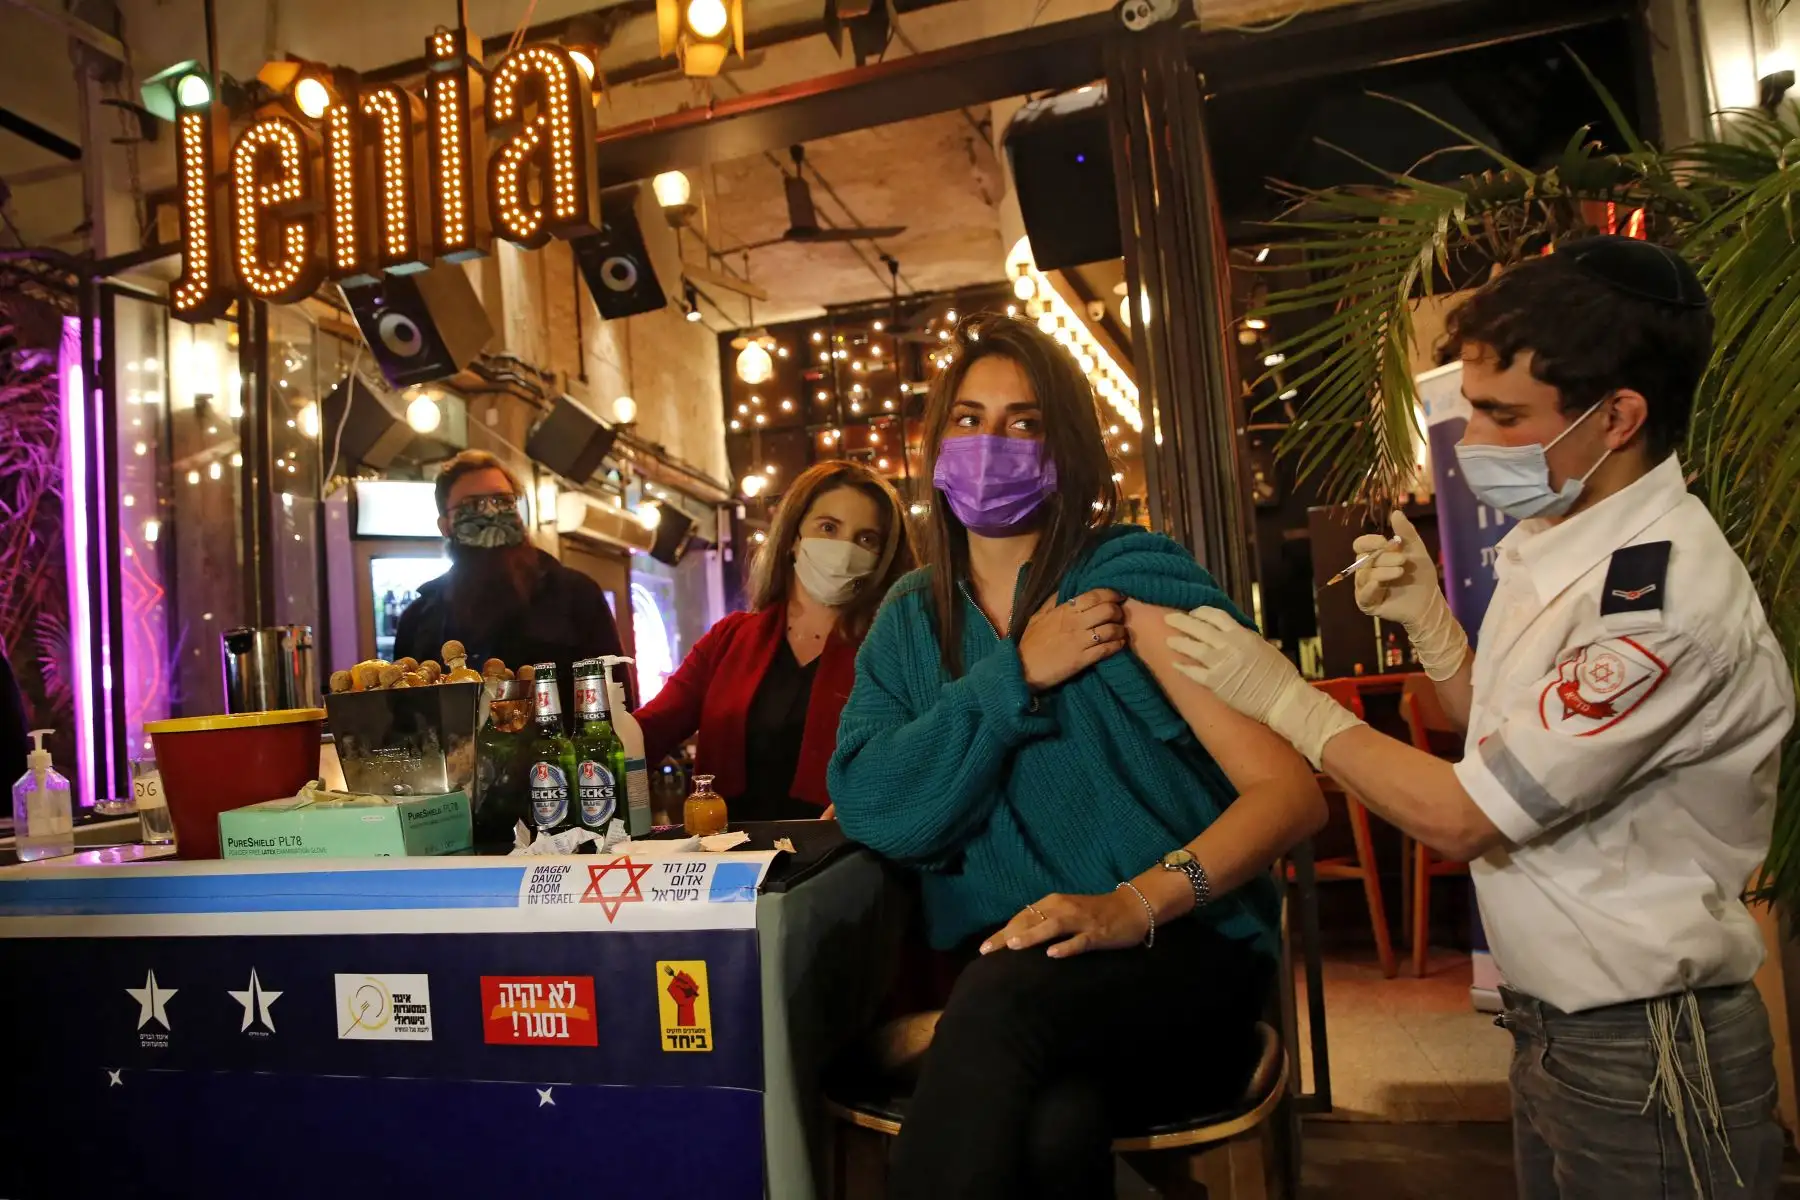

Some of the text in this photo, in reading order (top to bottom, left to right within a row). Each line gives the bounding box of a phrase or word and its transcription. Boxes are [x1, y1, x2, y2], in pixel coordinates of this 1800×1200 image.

[278, 835, 303, 847] PL78
[534, 865, 571, 874] MAGEN
[662, 863, 707, 873] מגן דוד
[531, 874, 562, 883] DAVID
[670, 875, 703, 886] אדום
[528, 883, 561, 893] ADOM
[527, 894, 573, 904] IN ISRAEL
[651, 888, 699, 902] בישראל
[499, 981, 576, 1008] לא יהיה
[511, 1011, 569, 1038] בסגר!
[667, 1035, 707, 1048] ביחד
